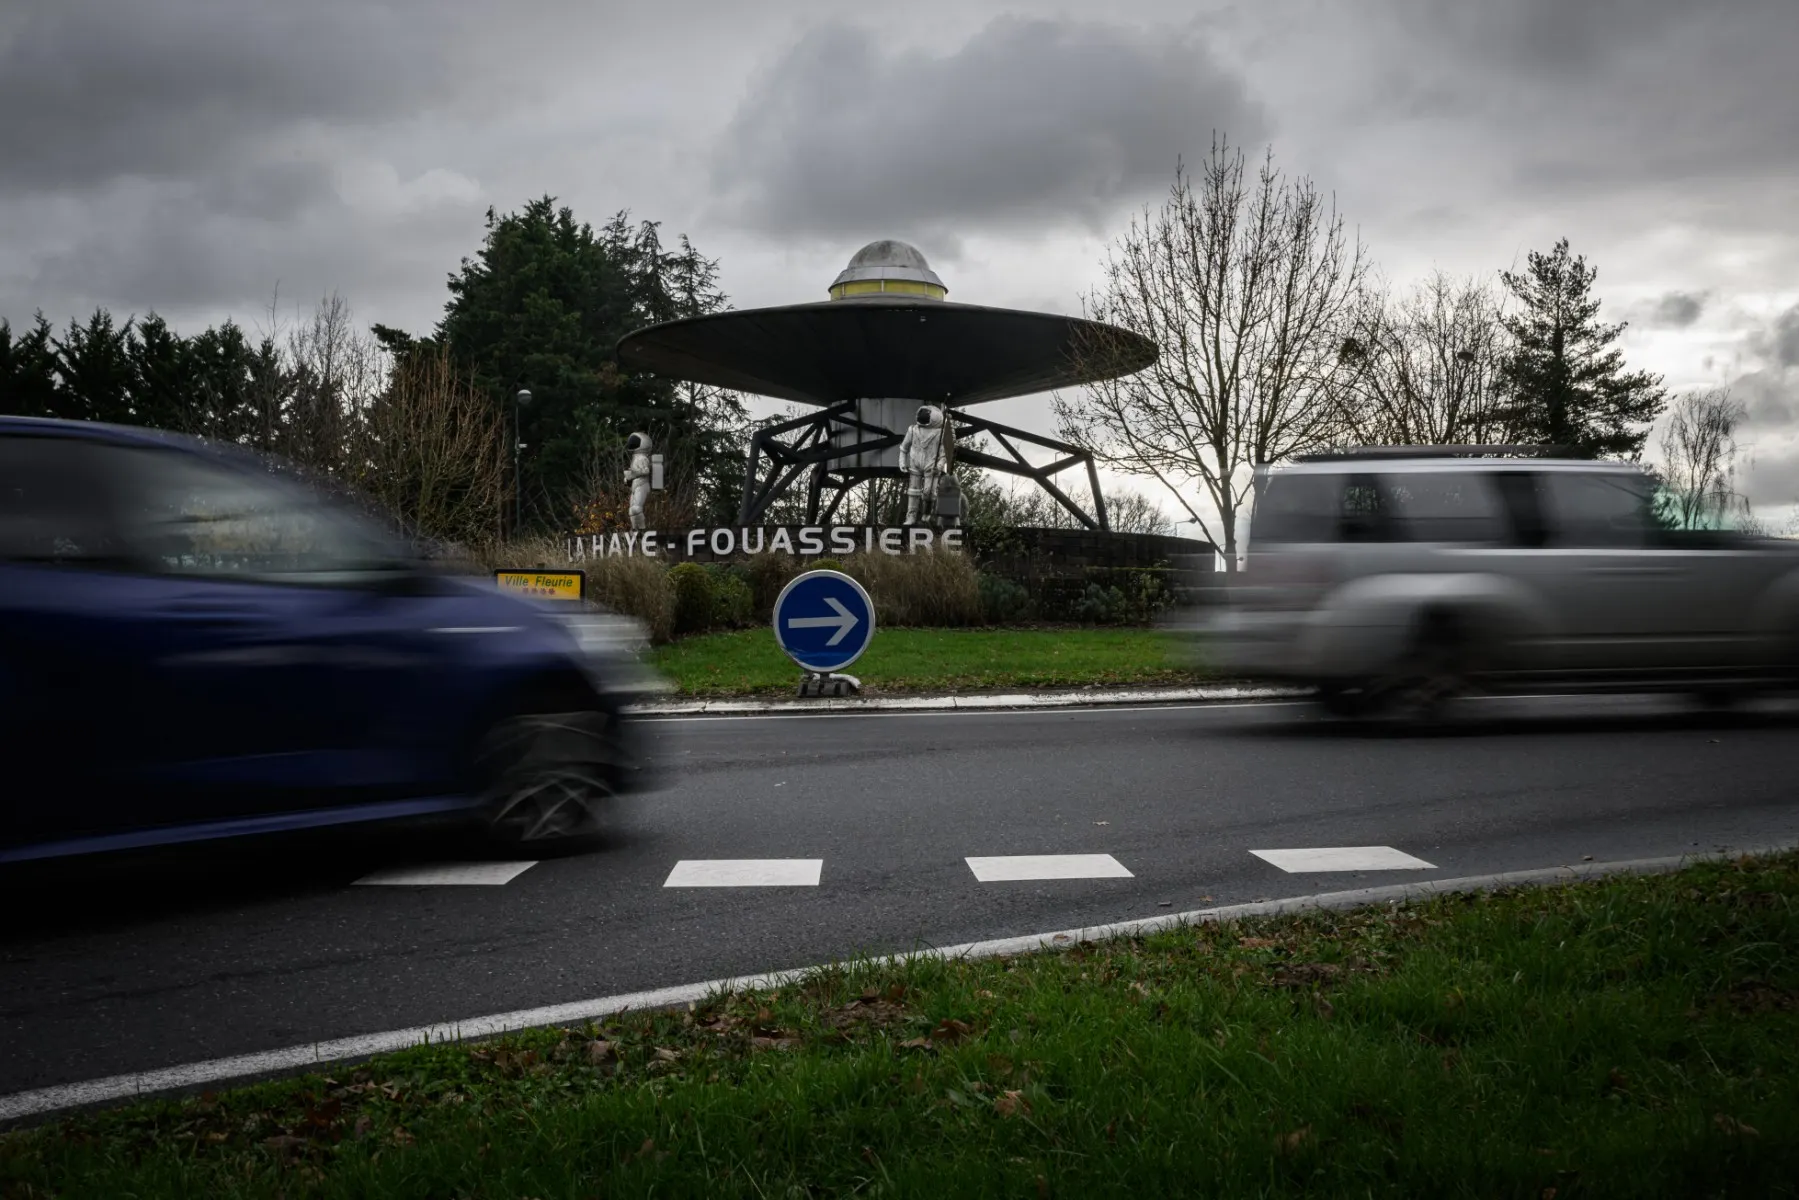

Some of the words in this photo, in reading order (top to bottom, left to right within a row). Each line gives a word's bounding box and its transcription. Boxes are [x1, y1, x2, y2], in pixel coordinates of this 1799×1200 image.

[592, 530, 657, 560] HAYE
[687, 526, 963, 556] FOUASSIERE
[505, 575, 529, 587] Ville
[535, 575, 573, 588] Fleurie
